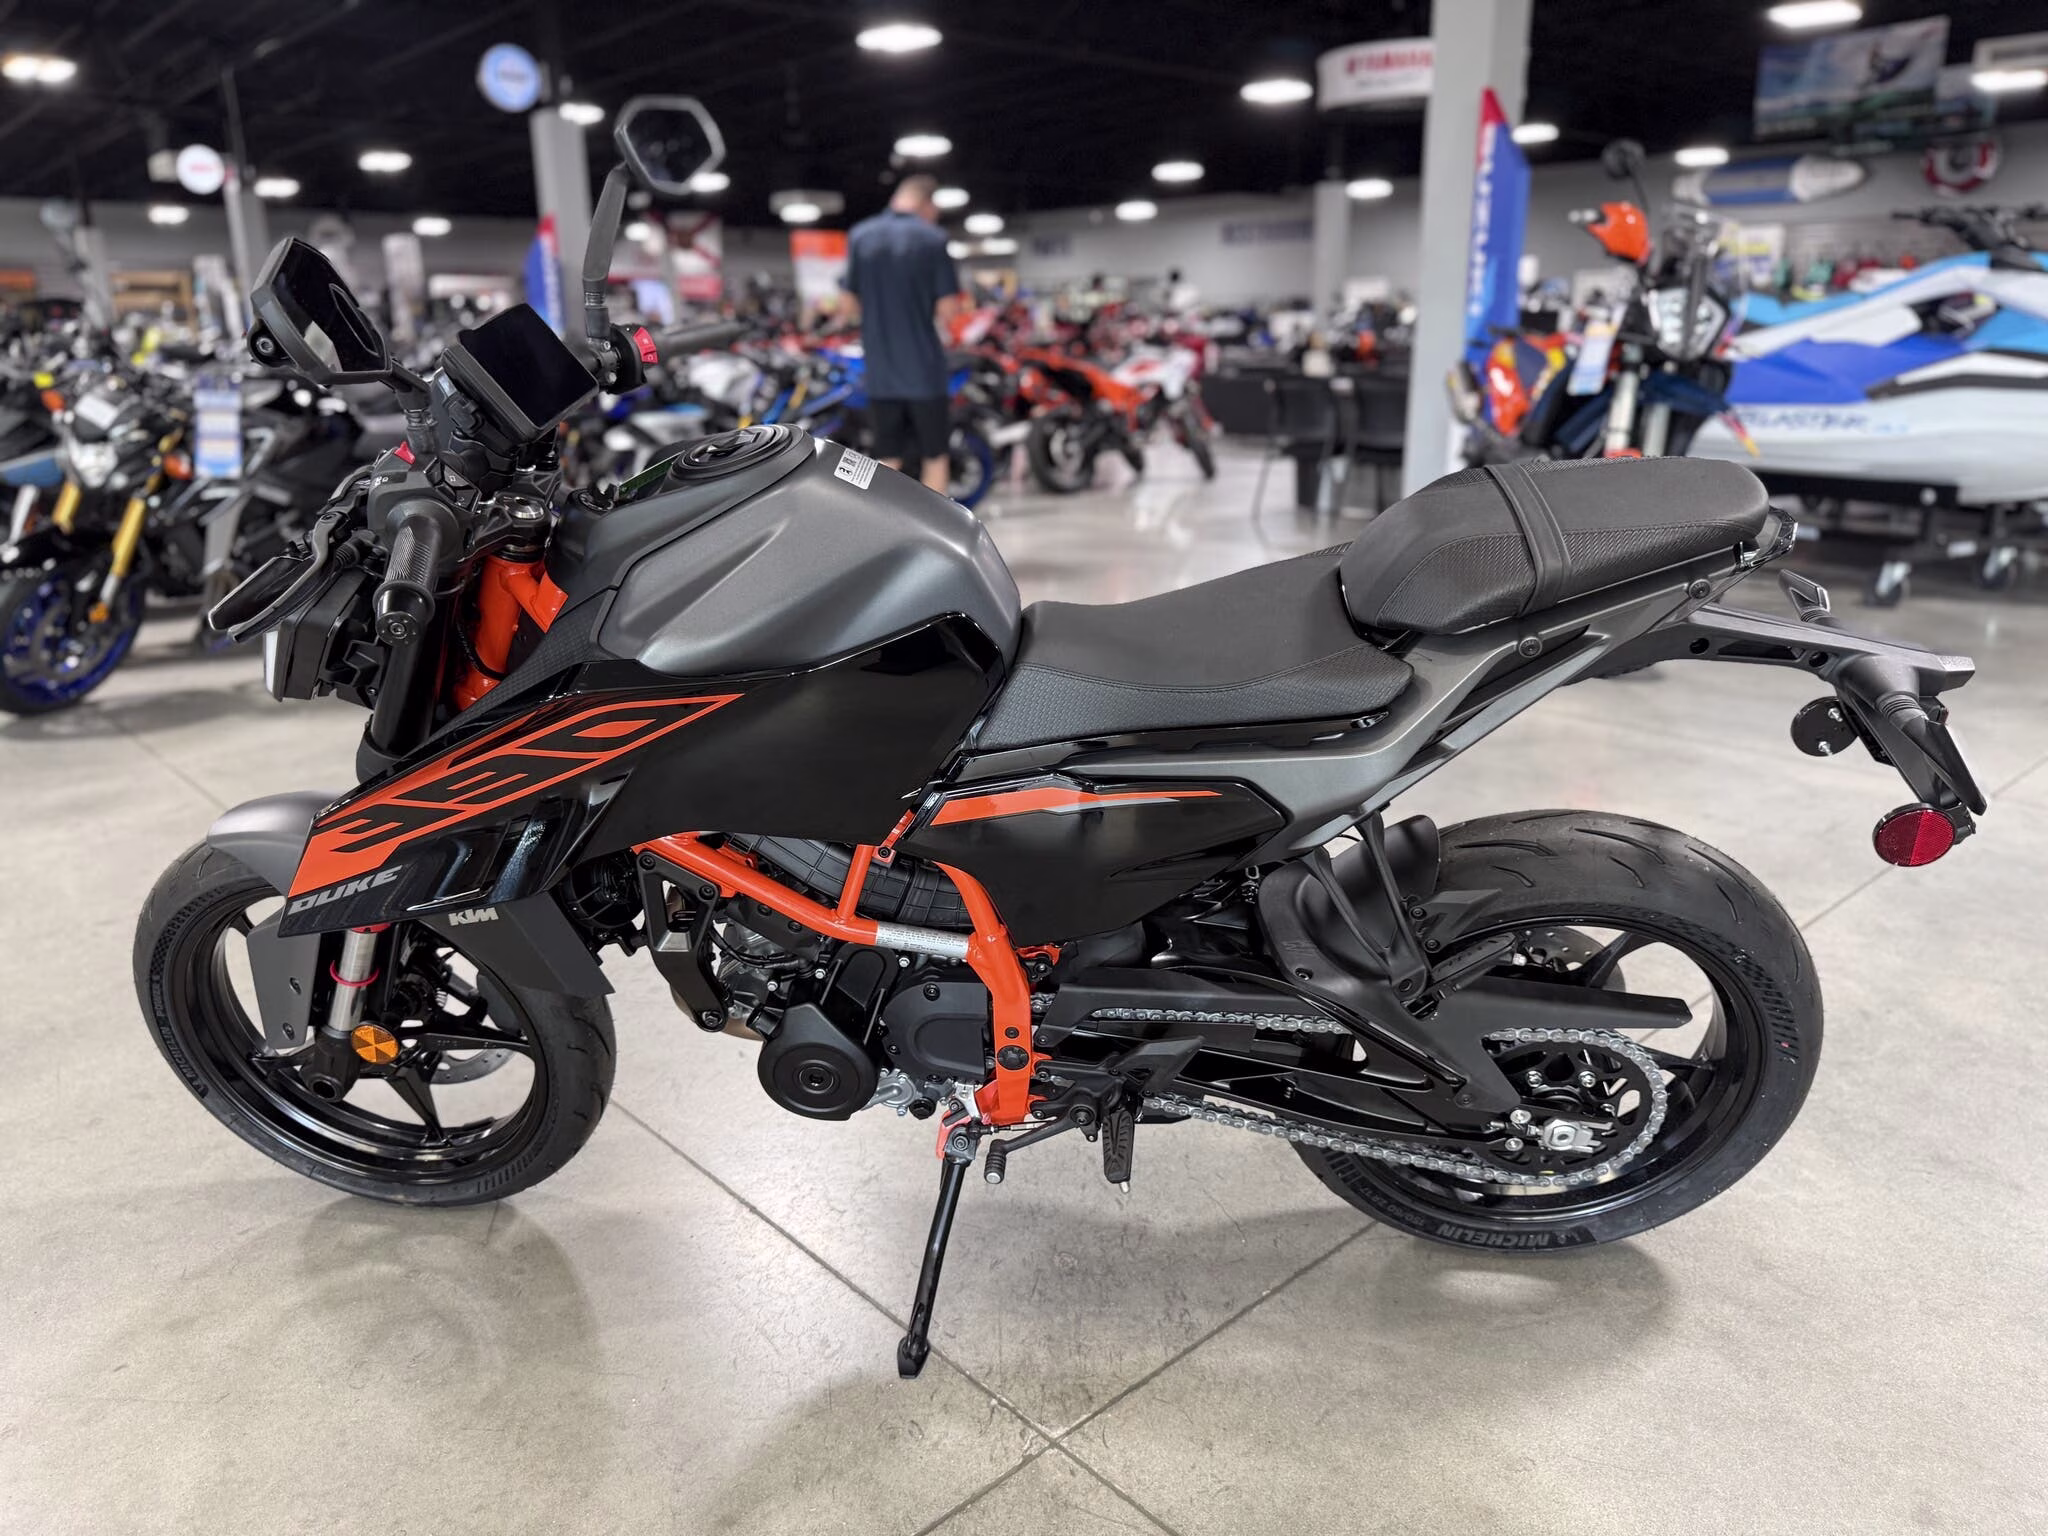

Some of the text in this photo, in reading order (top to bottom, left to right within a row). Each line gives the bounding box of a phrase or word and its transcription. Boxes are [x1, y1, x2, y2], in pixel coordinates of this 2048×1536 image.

[287, 864, 403, 916] DUKE
[448, 907, 499, 926] KTM
[160, 1026, 196, 1078] MICHELIN
[1436, 1224, 1551, 1248] MICHELIN
